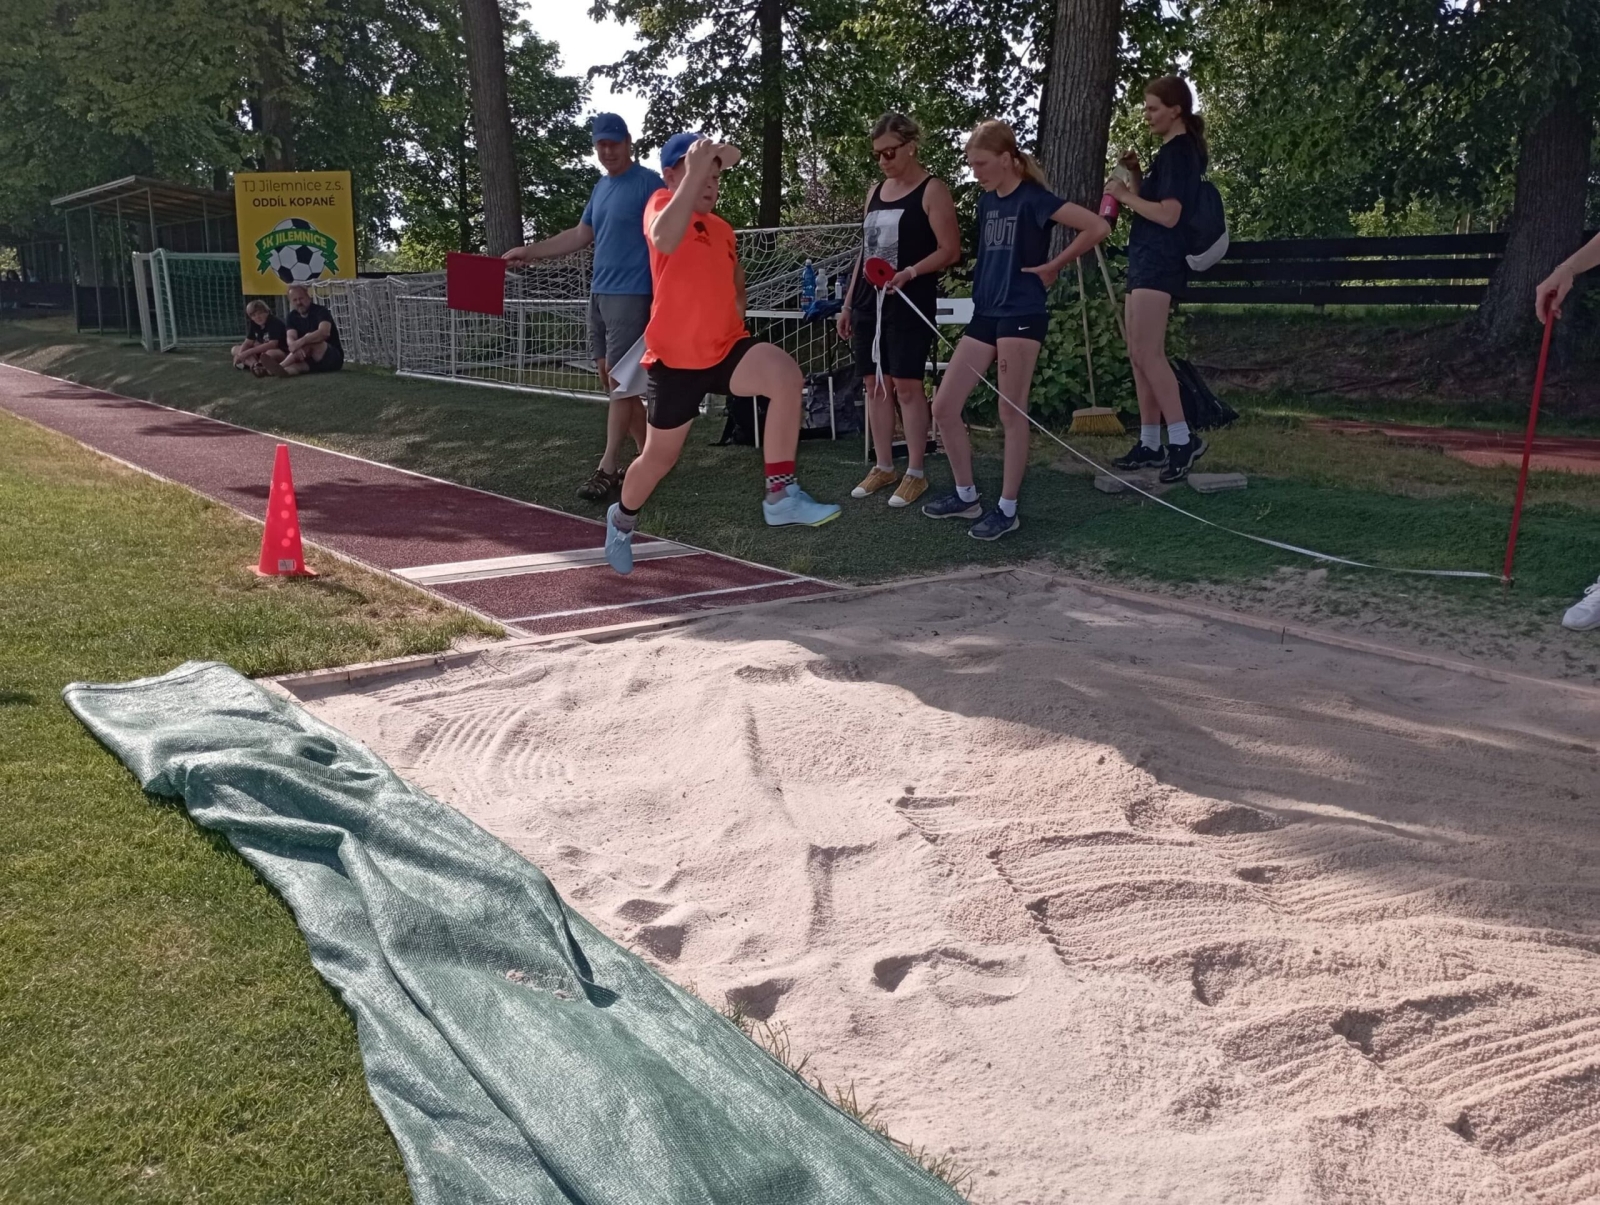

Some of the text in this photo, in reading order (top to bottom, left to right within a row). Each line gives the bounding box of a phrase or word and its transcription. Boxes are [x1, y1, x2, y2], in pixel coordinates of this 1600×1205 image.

[242, 179, 344, 192] TJ Jilemnice z.s.
[252, 195, 336, 207] ODDÍL KOPANÉ
[985, 216, 1017, 246] OUT
[262, 231, 327, 250] SK JILEMNICE
